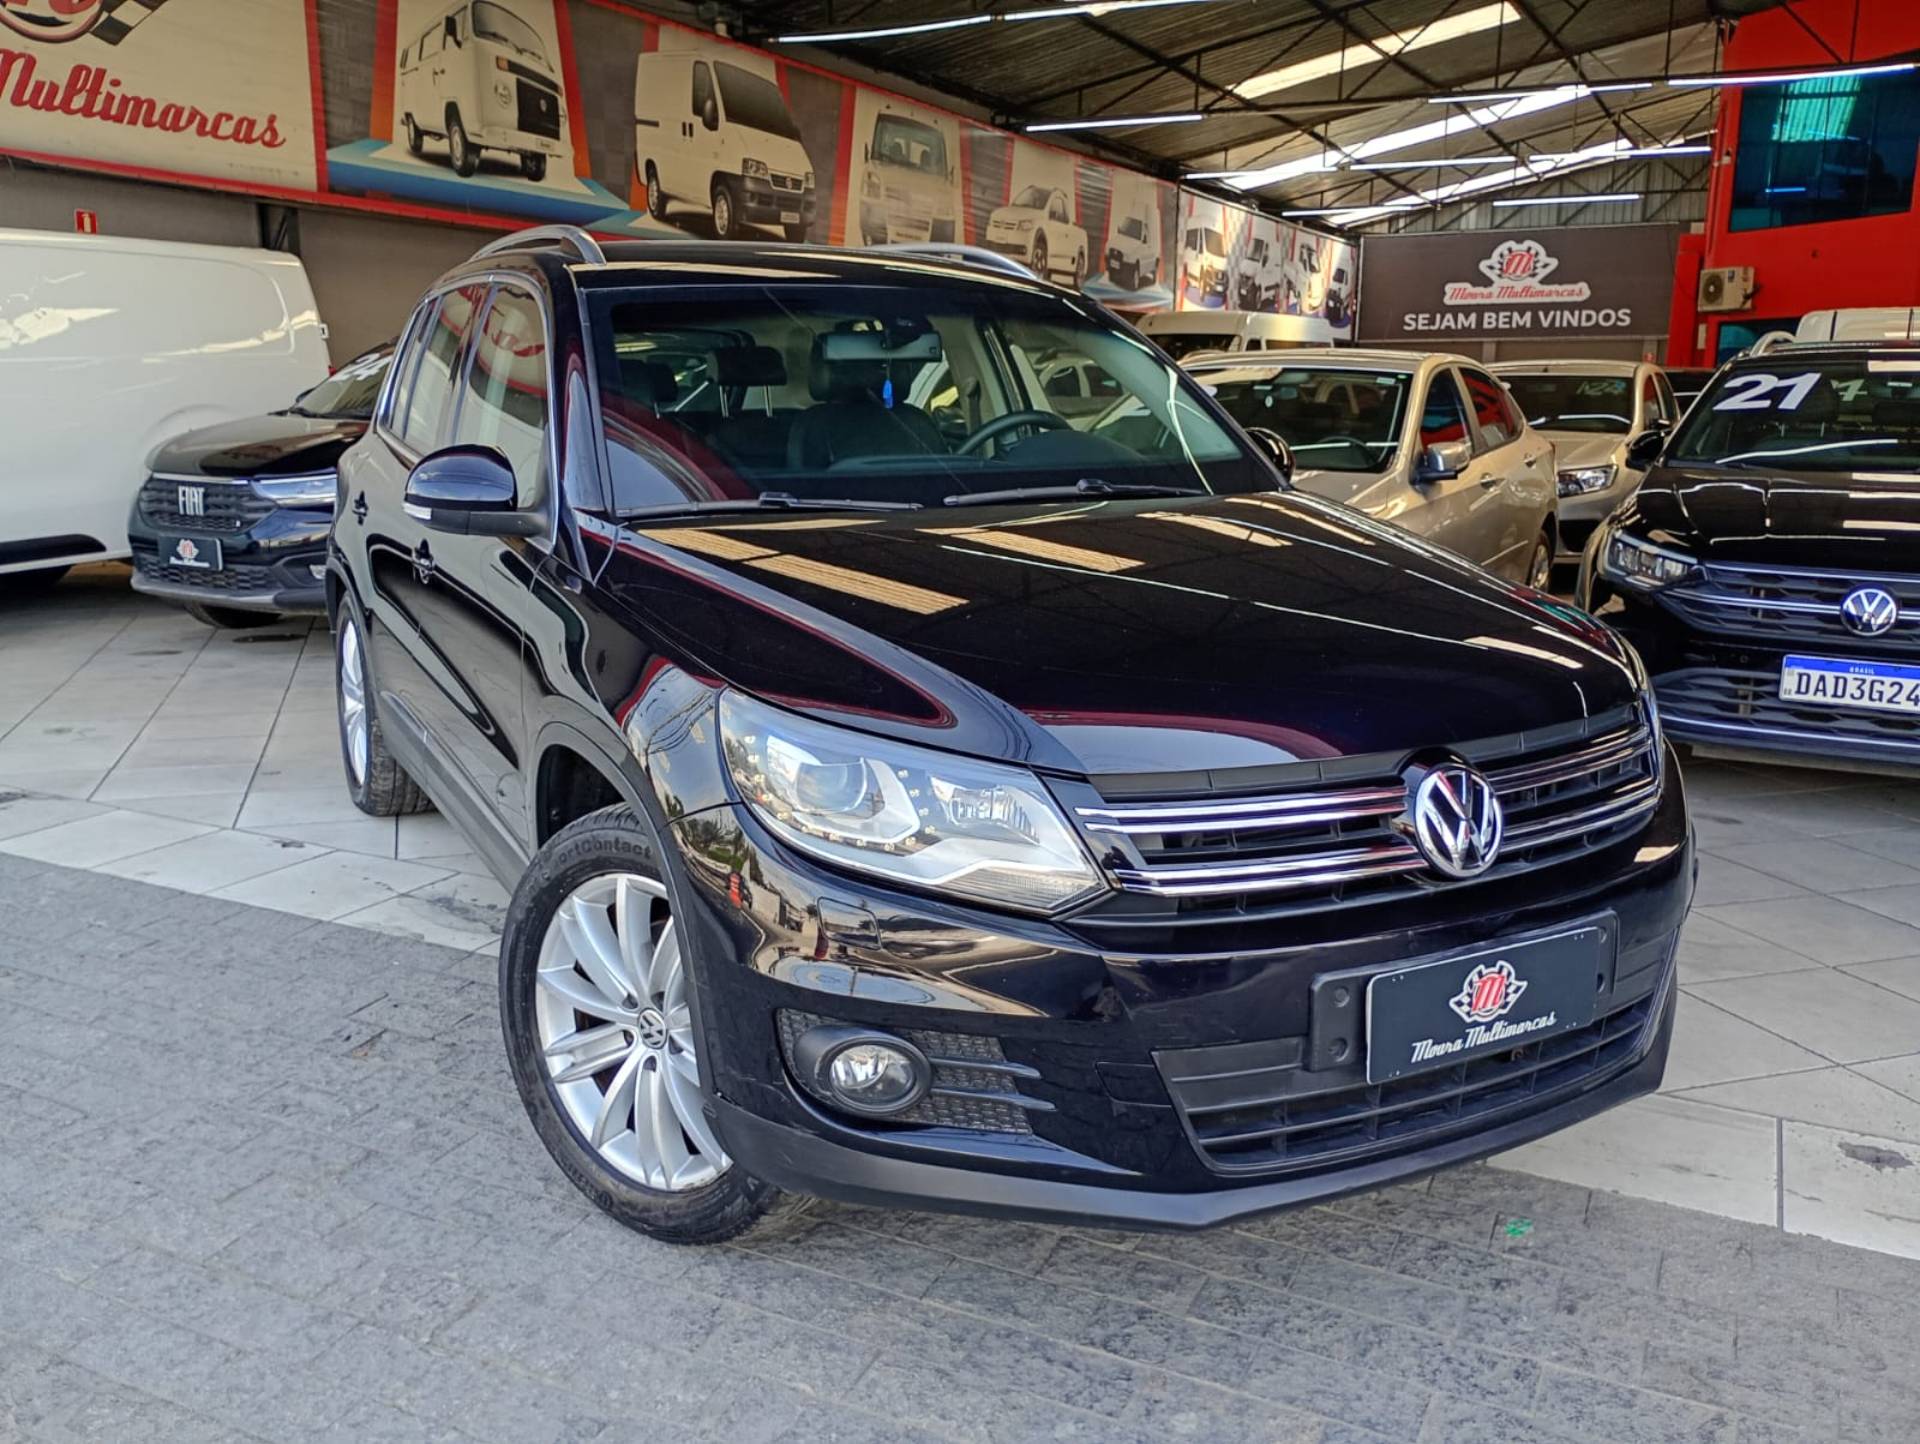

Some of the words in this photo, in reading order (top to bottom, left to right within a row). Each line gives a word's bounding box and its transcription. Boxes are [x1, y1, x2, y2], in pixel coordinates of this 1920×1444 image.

[1403, 312, 1476, 331] SEJAM
[1482, 310, 1532, 329] BEM
[1538, 308, 1632, 328] VINDOS
[1712, 372, 1822, 411] 21
[178, 485, 205, 516] FIAT
[1794, 671, 1920, 707] DAD3G24
[1411, 1038, 1464, 1064] Moura
[1464, 1010, 1557, 1049] Multimarcas
